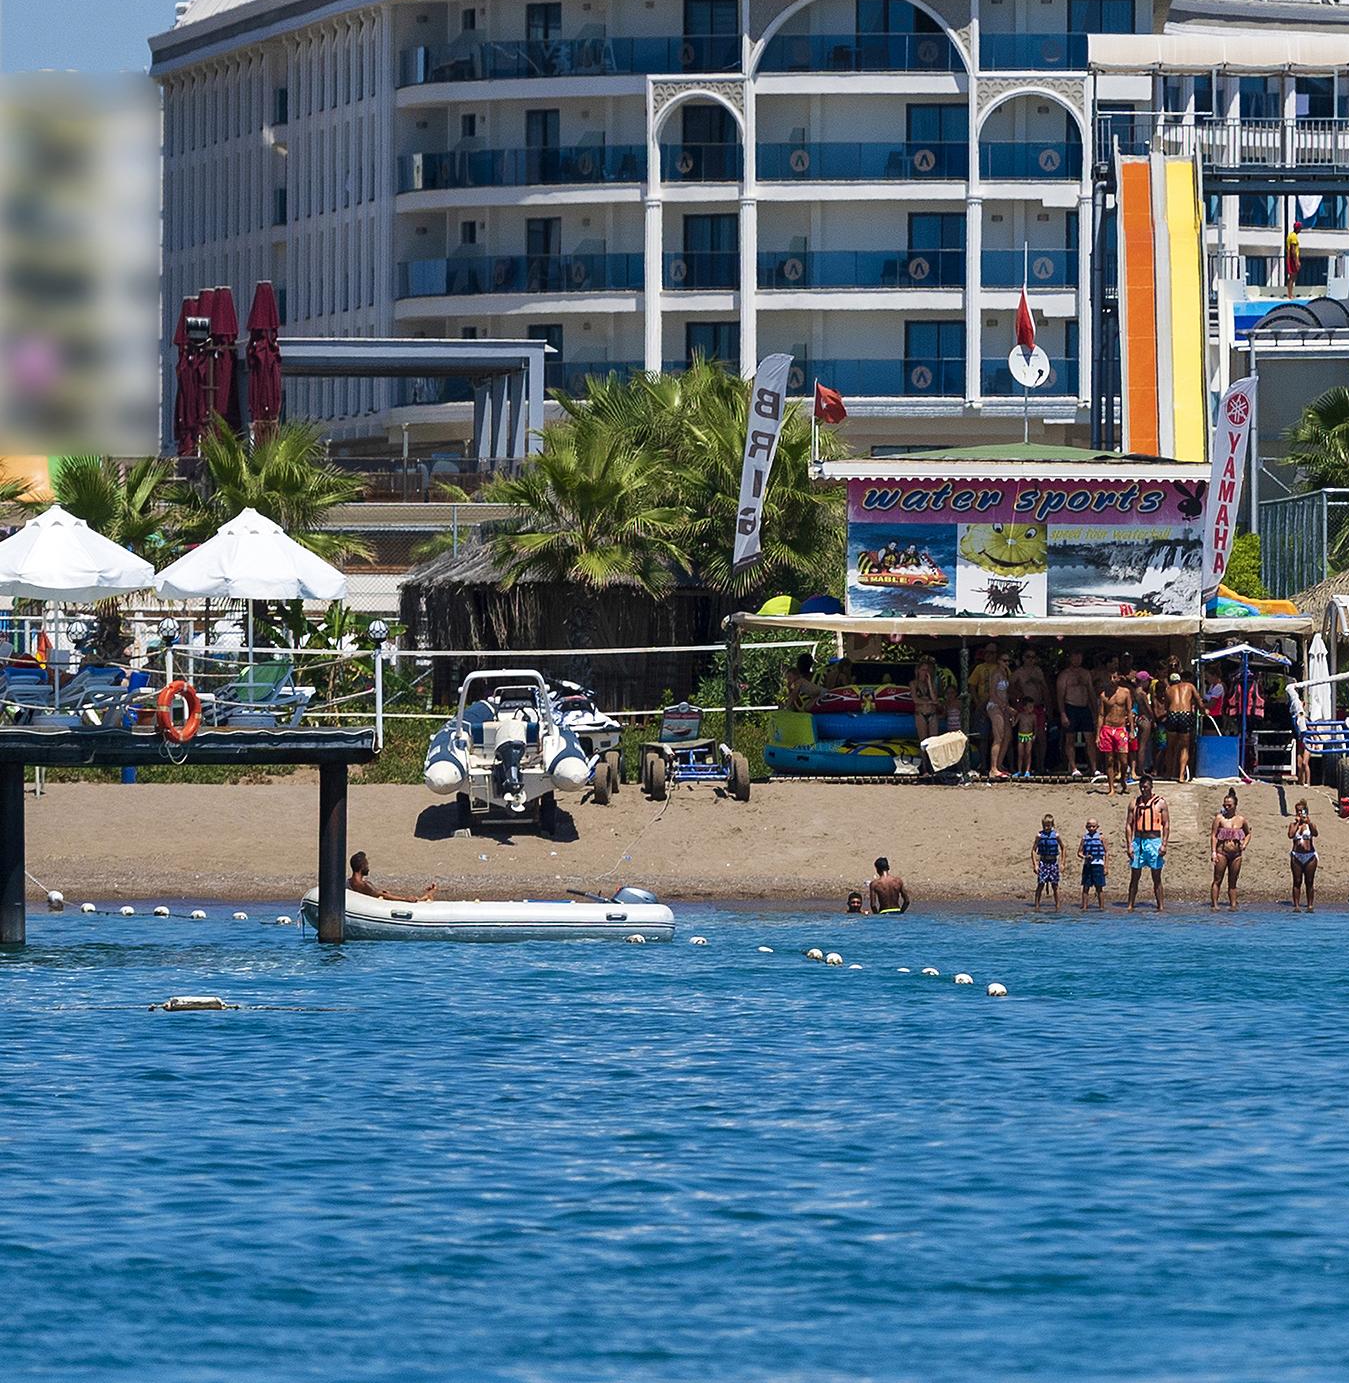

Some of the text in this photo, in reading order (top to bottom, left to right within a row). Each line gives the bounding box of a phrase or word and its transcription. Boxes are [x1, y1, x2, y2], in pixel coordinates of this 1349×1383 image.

[862, 481, 1167, 522] water sports
[1213, 431, 1242, 574] YAMAHA
